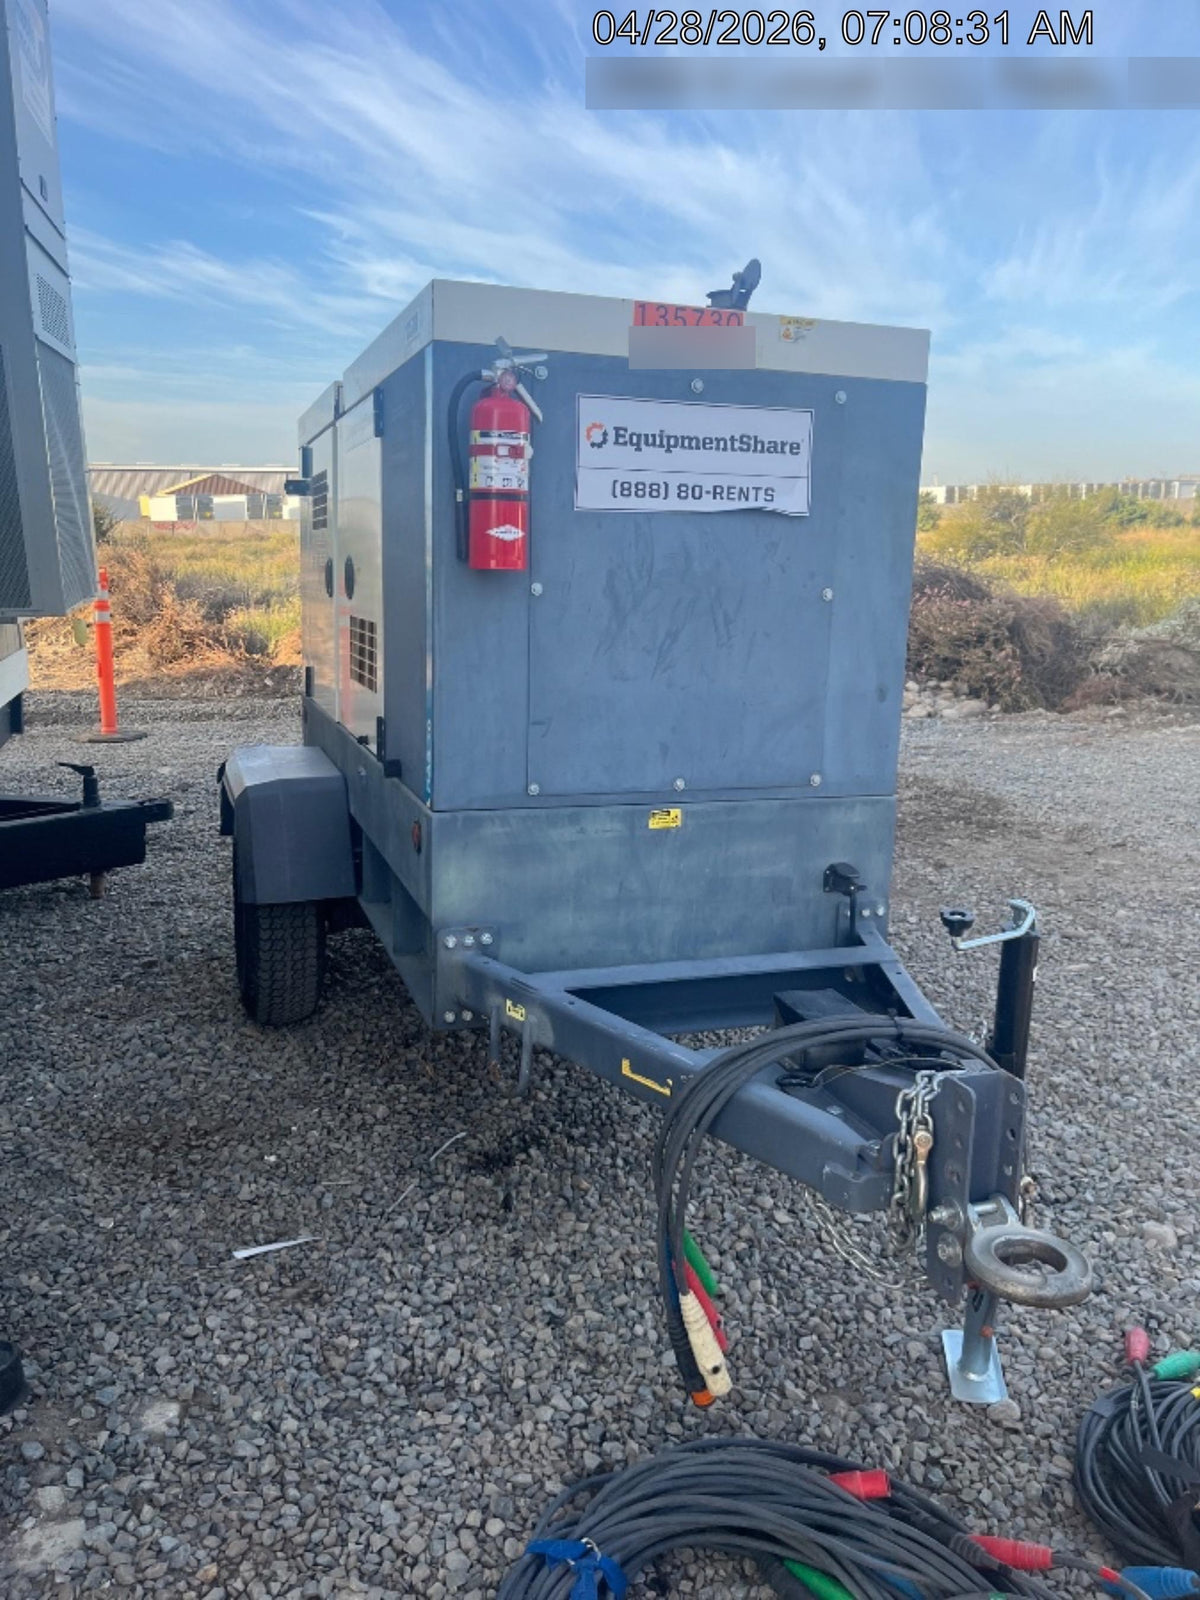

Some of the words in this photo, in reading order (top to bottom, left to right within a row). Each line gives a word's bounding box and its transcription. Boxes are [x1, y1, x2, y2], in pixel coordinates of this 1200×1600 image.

[613, 426, 801, 456] EquipmentShare
[611, 480, 669, 499] (888)
[676, 483, 776, 502] 80-RENTS
